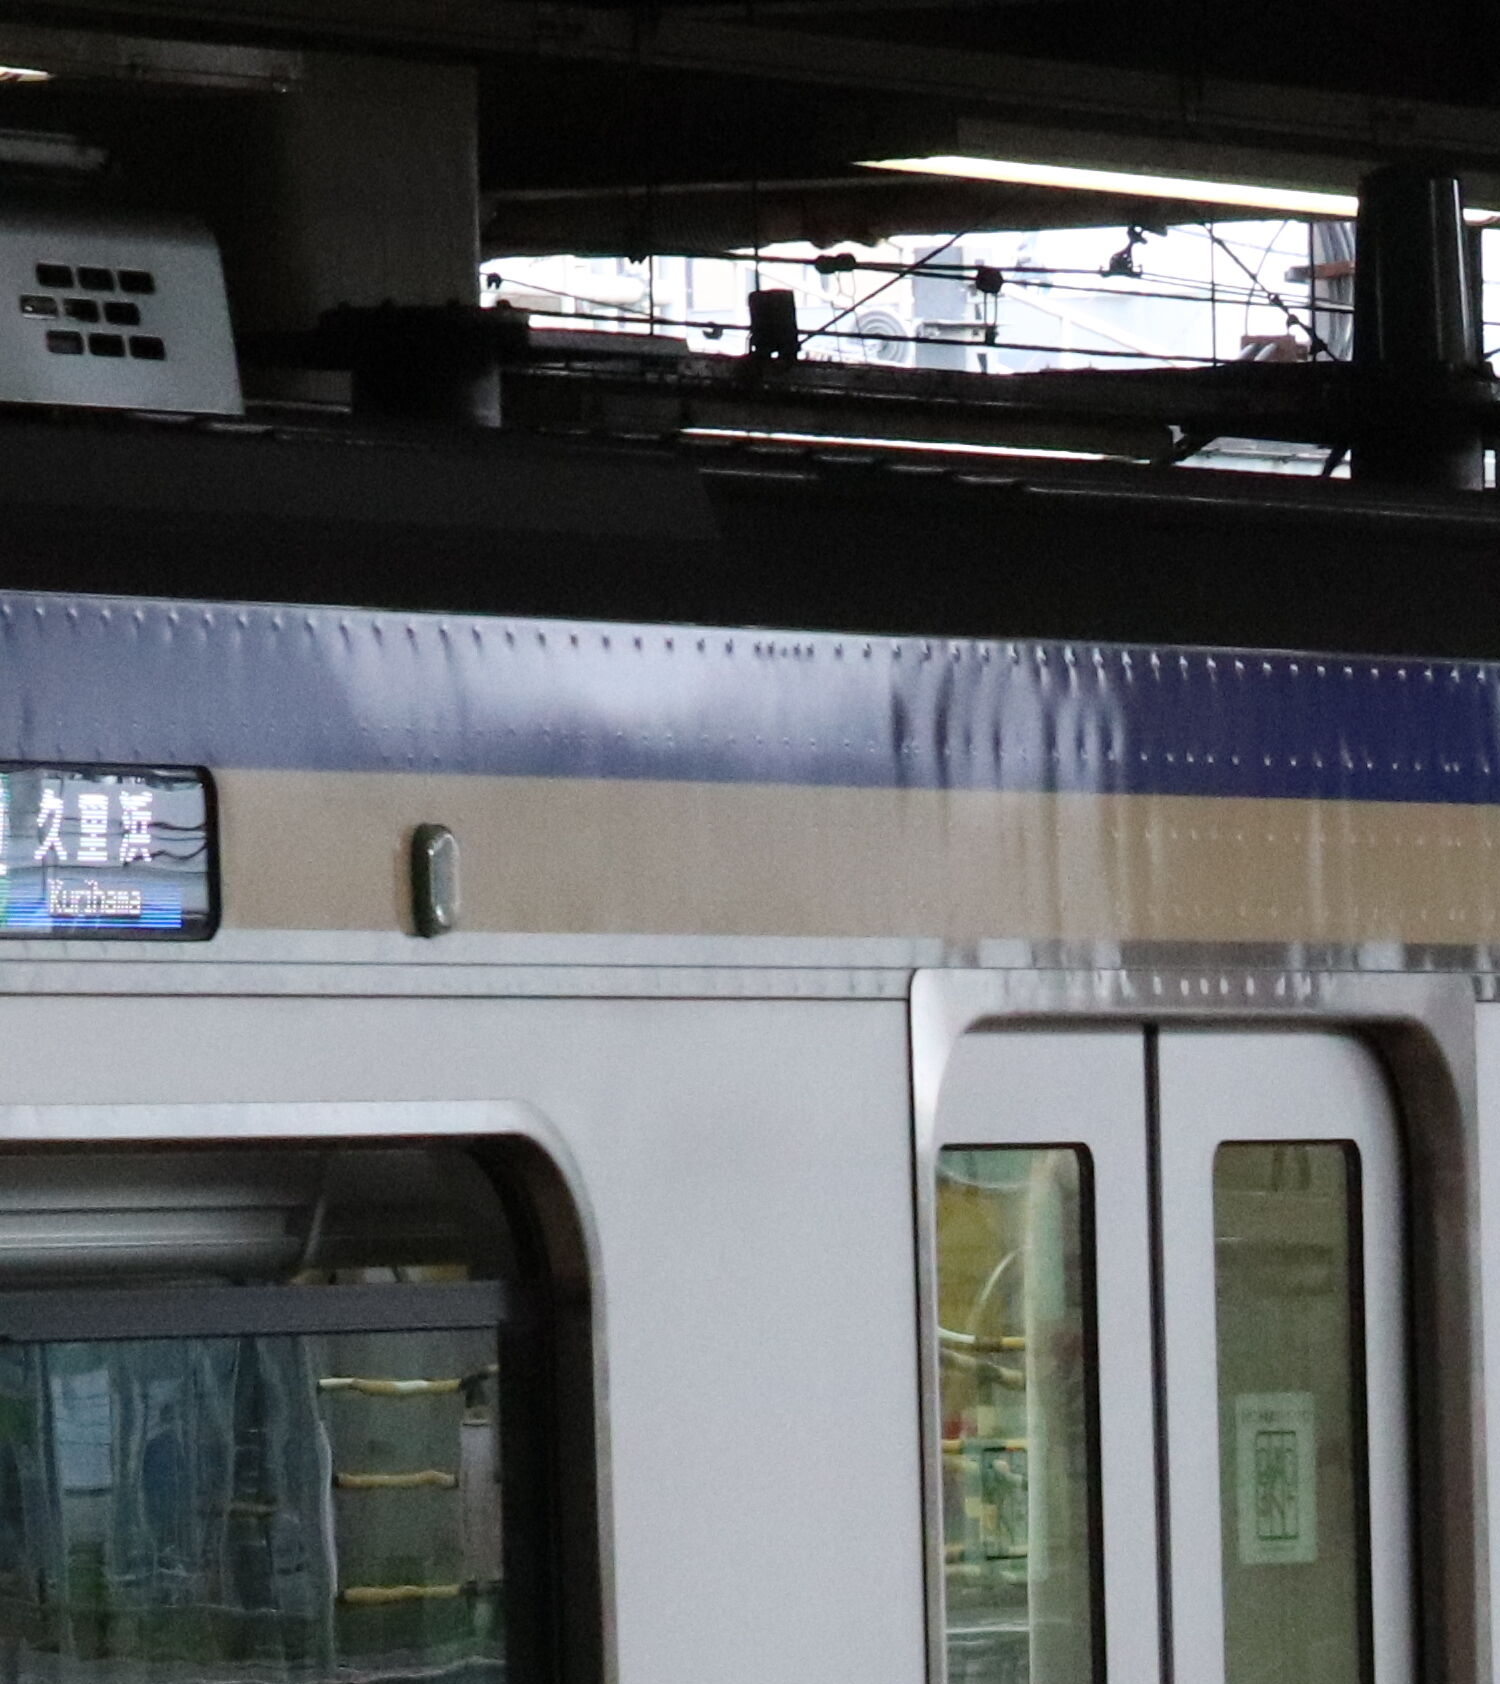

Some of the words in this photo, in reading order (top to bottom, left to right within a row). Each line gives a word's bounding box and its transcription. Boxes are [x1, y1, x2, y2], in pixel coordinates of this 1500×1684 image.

[34, 788, 152, 862] 久里浜
[48, 879, 141, 915] Kurihama
